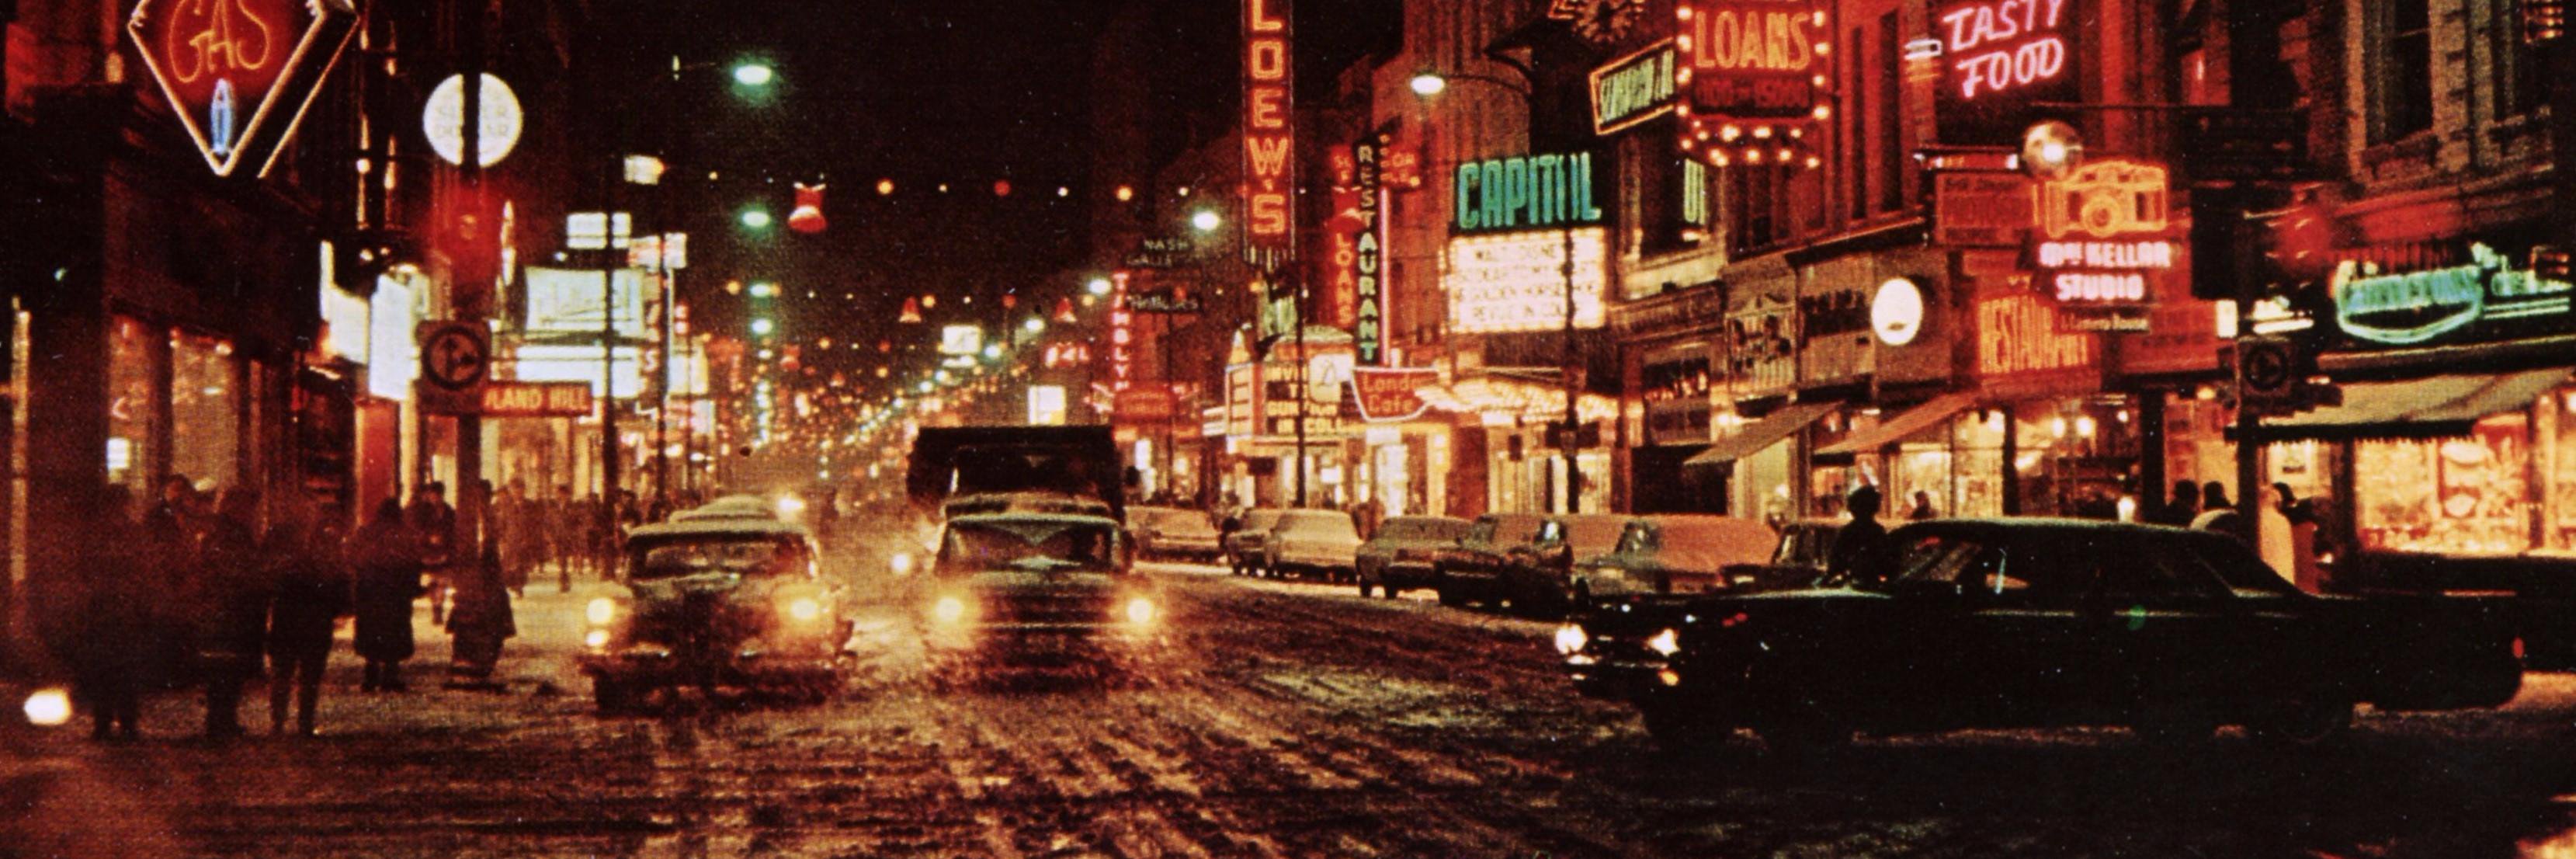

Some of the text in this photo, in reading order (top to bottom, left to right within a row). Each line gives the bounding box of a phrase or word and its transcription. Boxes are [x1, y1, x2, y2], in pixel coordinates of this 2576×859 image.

[168, 0, 270, 82] GAS
[1695, 10, 1812, 70] LOANS
[1943, 0, 2064, 50] TASTY
[1956, 38, 2064, 98] FOOD
[1458, 151, 1602, 230] CAPITOL
[1358, 145, 1378, 361] RESTAURANT
[2056, 272, 2144, 302] STUDIO
[549, 387, 589, 412] HILL
